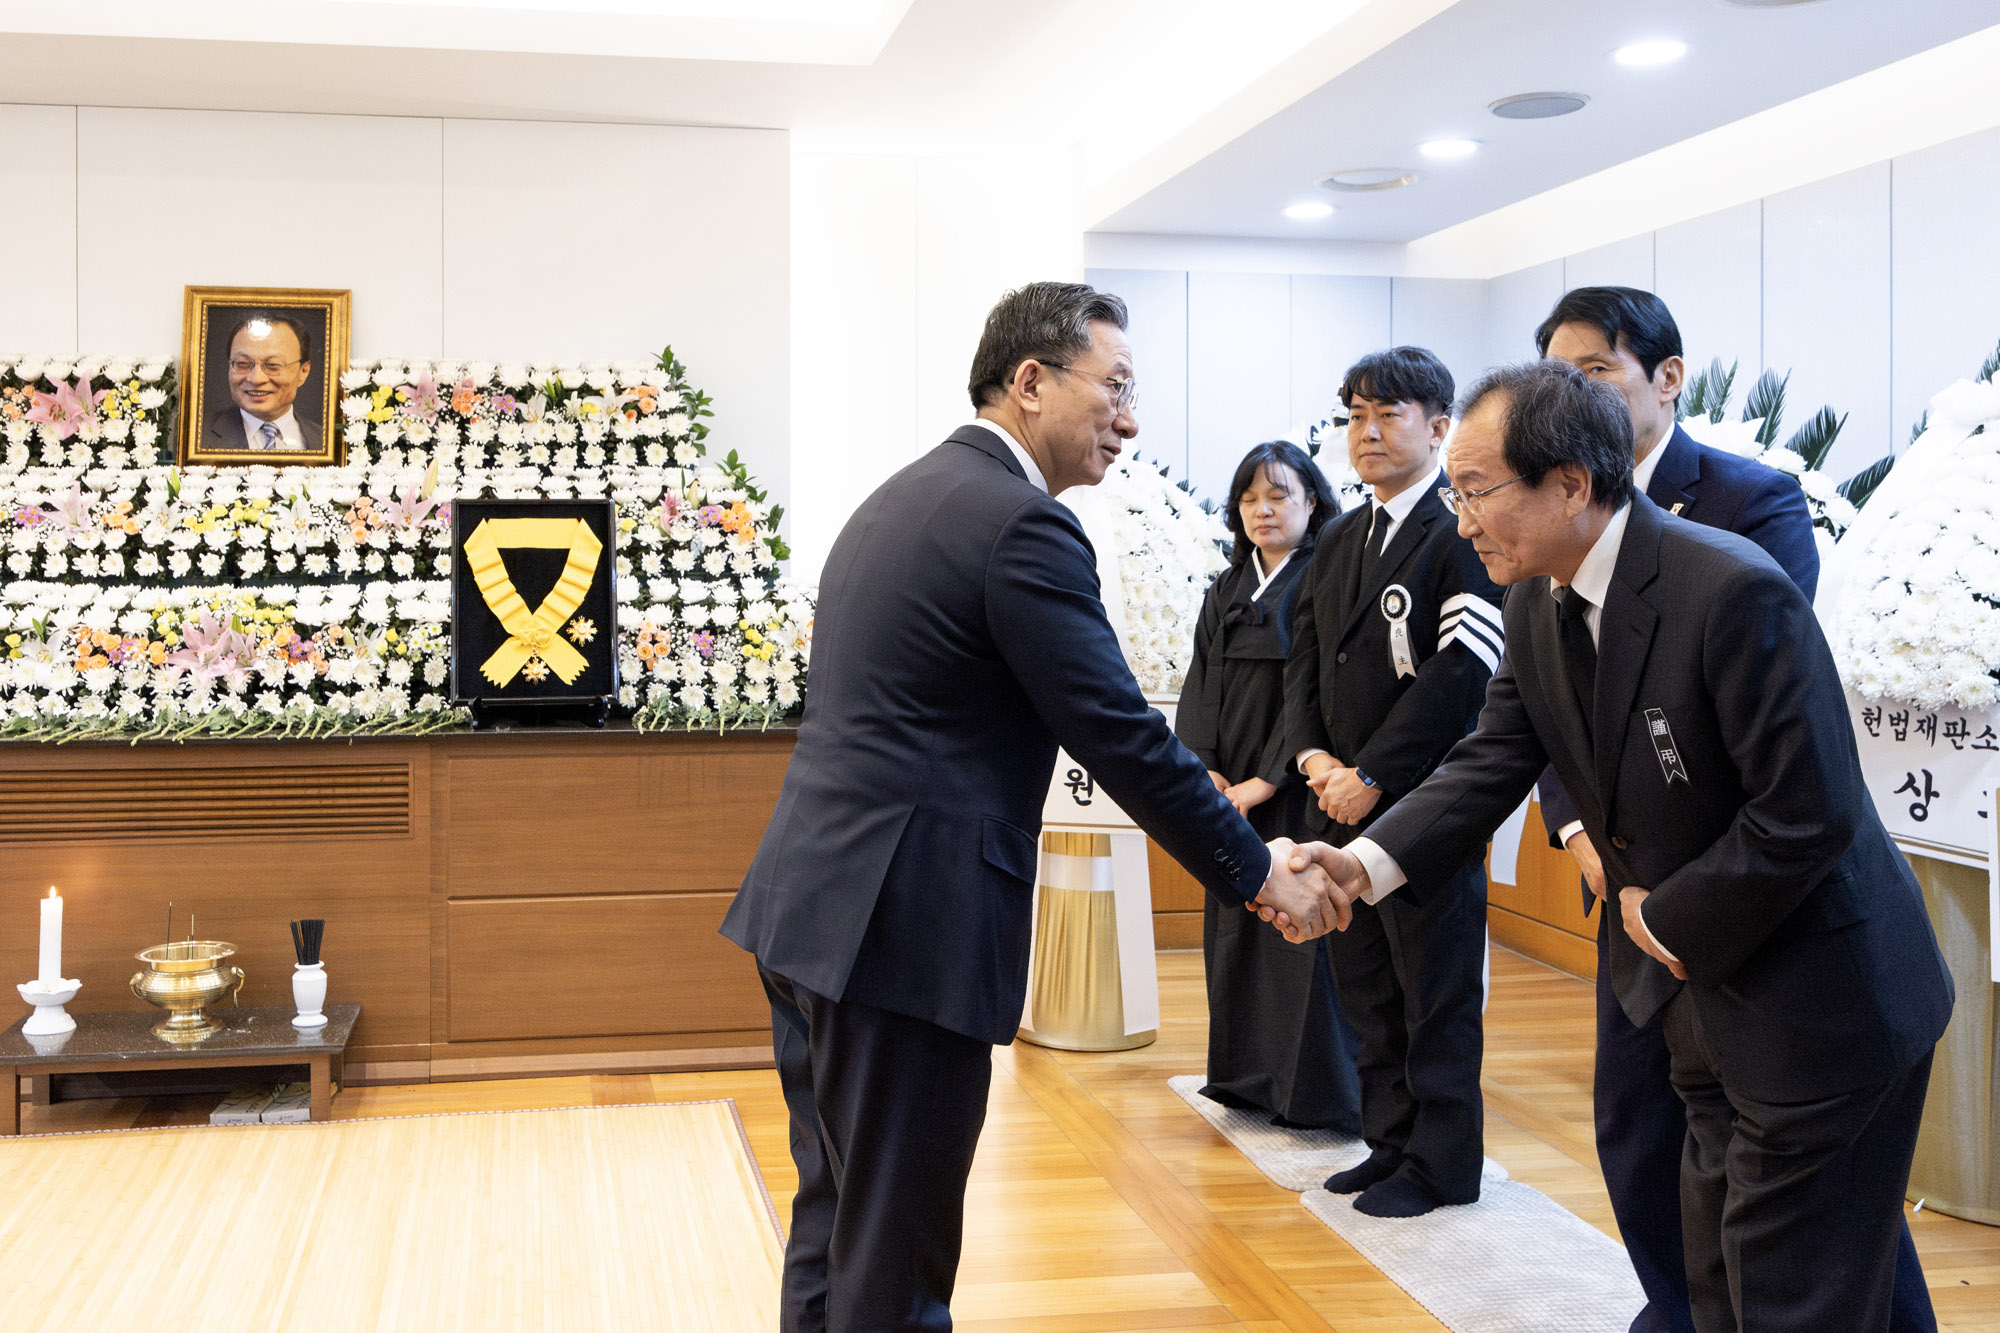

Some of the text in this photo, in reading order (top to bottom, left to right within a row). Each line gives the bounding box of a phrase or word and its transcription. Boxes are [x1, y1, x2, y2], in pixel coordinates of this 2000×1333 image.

[1651, 718, 1676, 765] 謹弔
[1861, 705, 2000, 751] 헌법재판소
[1063, 768, 1094, 807] 원
[1893, 768, 1940, 822] 상
